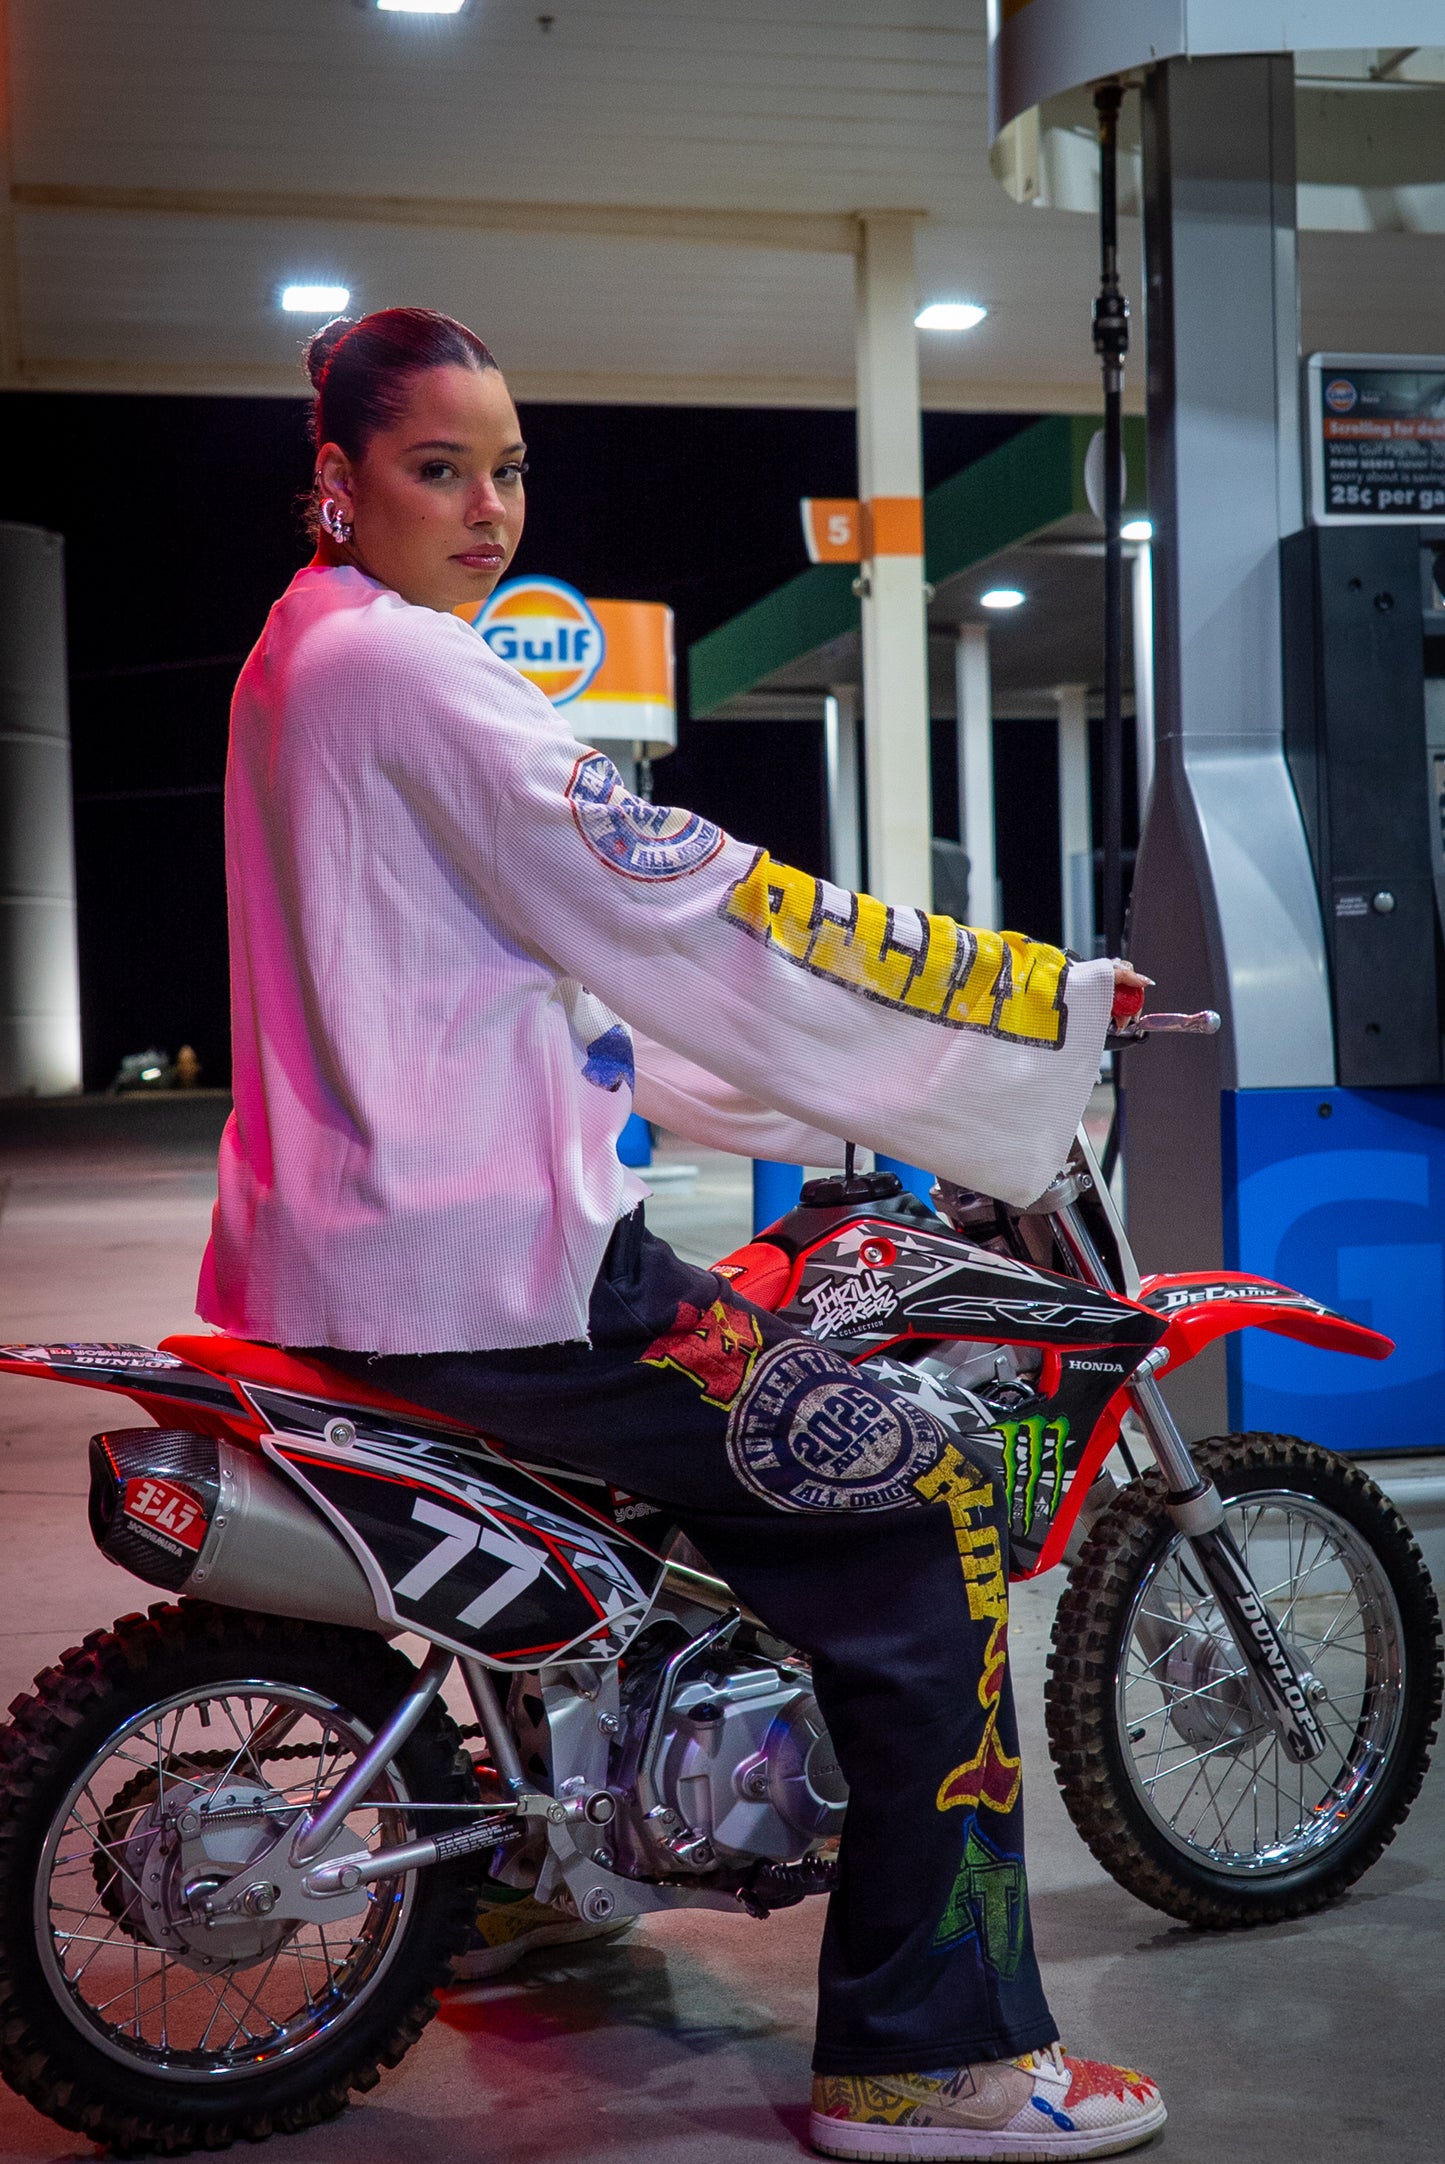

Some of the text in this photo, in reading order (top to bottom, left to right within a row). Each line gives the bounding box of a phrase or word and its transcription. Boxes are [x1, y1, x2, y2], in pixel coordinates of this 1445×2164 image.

[1330, 422, 1391, 438] Scrolling
[1394, 422, 1415, 435] for
[1378, 489, 1415, 509] per
[828, 515, 851, 546] 5
[484, 626, 591, 664] Gulf
[903, 1295, 1141, 1327] CRF
[839, 1320, 885, 1337] COLLECTION
[74, 1356, 181, 1369] DUNLOP
[1069, 1360, 1124, 1374] HONDA
[792, 1387, 883, 1468] 2025
[798, 1484, 841, 1507] ALL
[127, 1520, 183, 1557] YOSHIMURA
[393, 1497, 549, 1630] 77
[1236, 1591, 1319, 1733] DUNLOP
